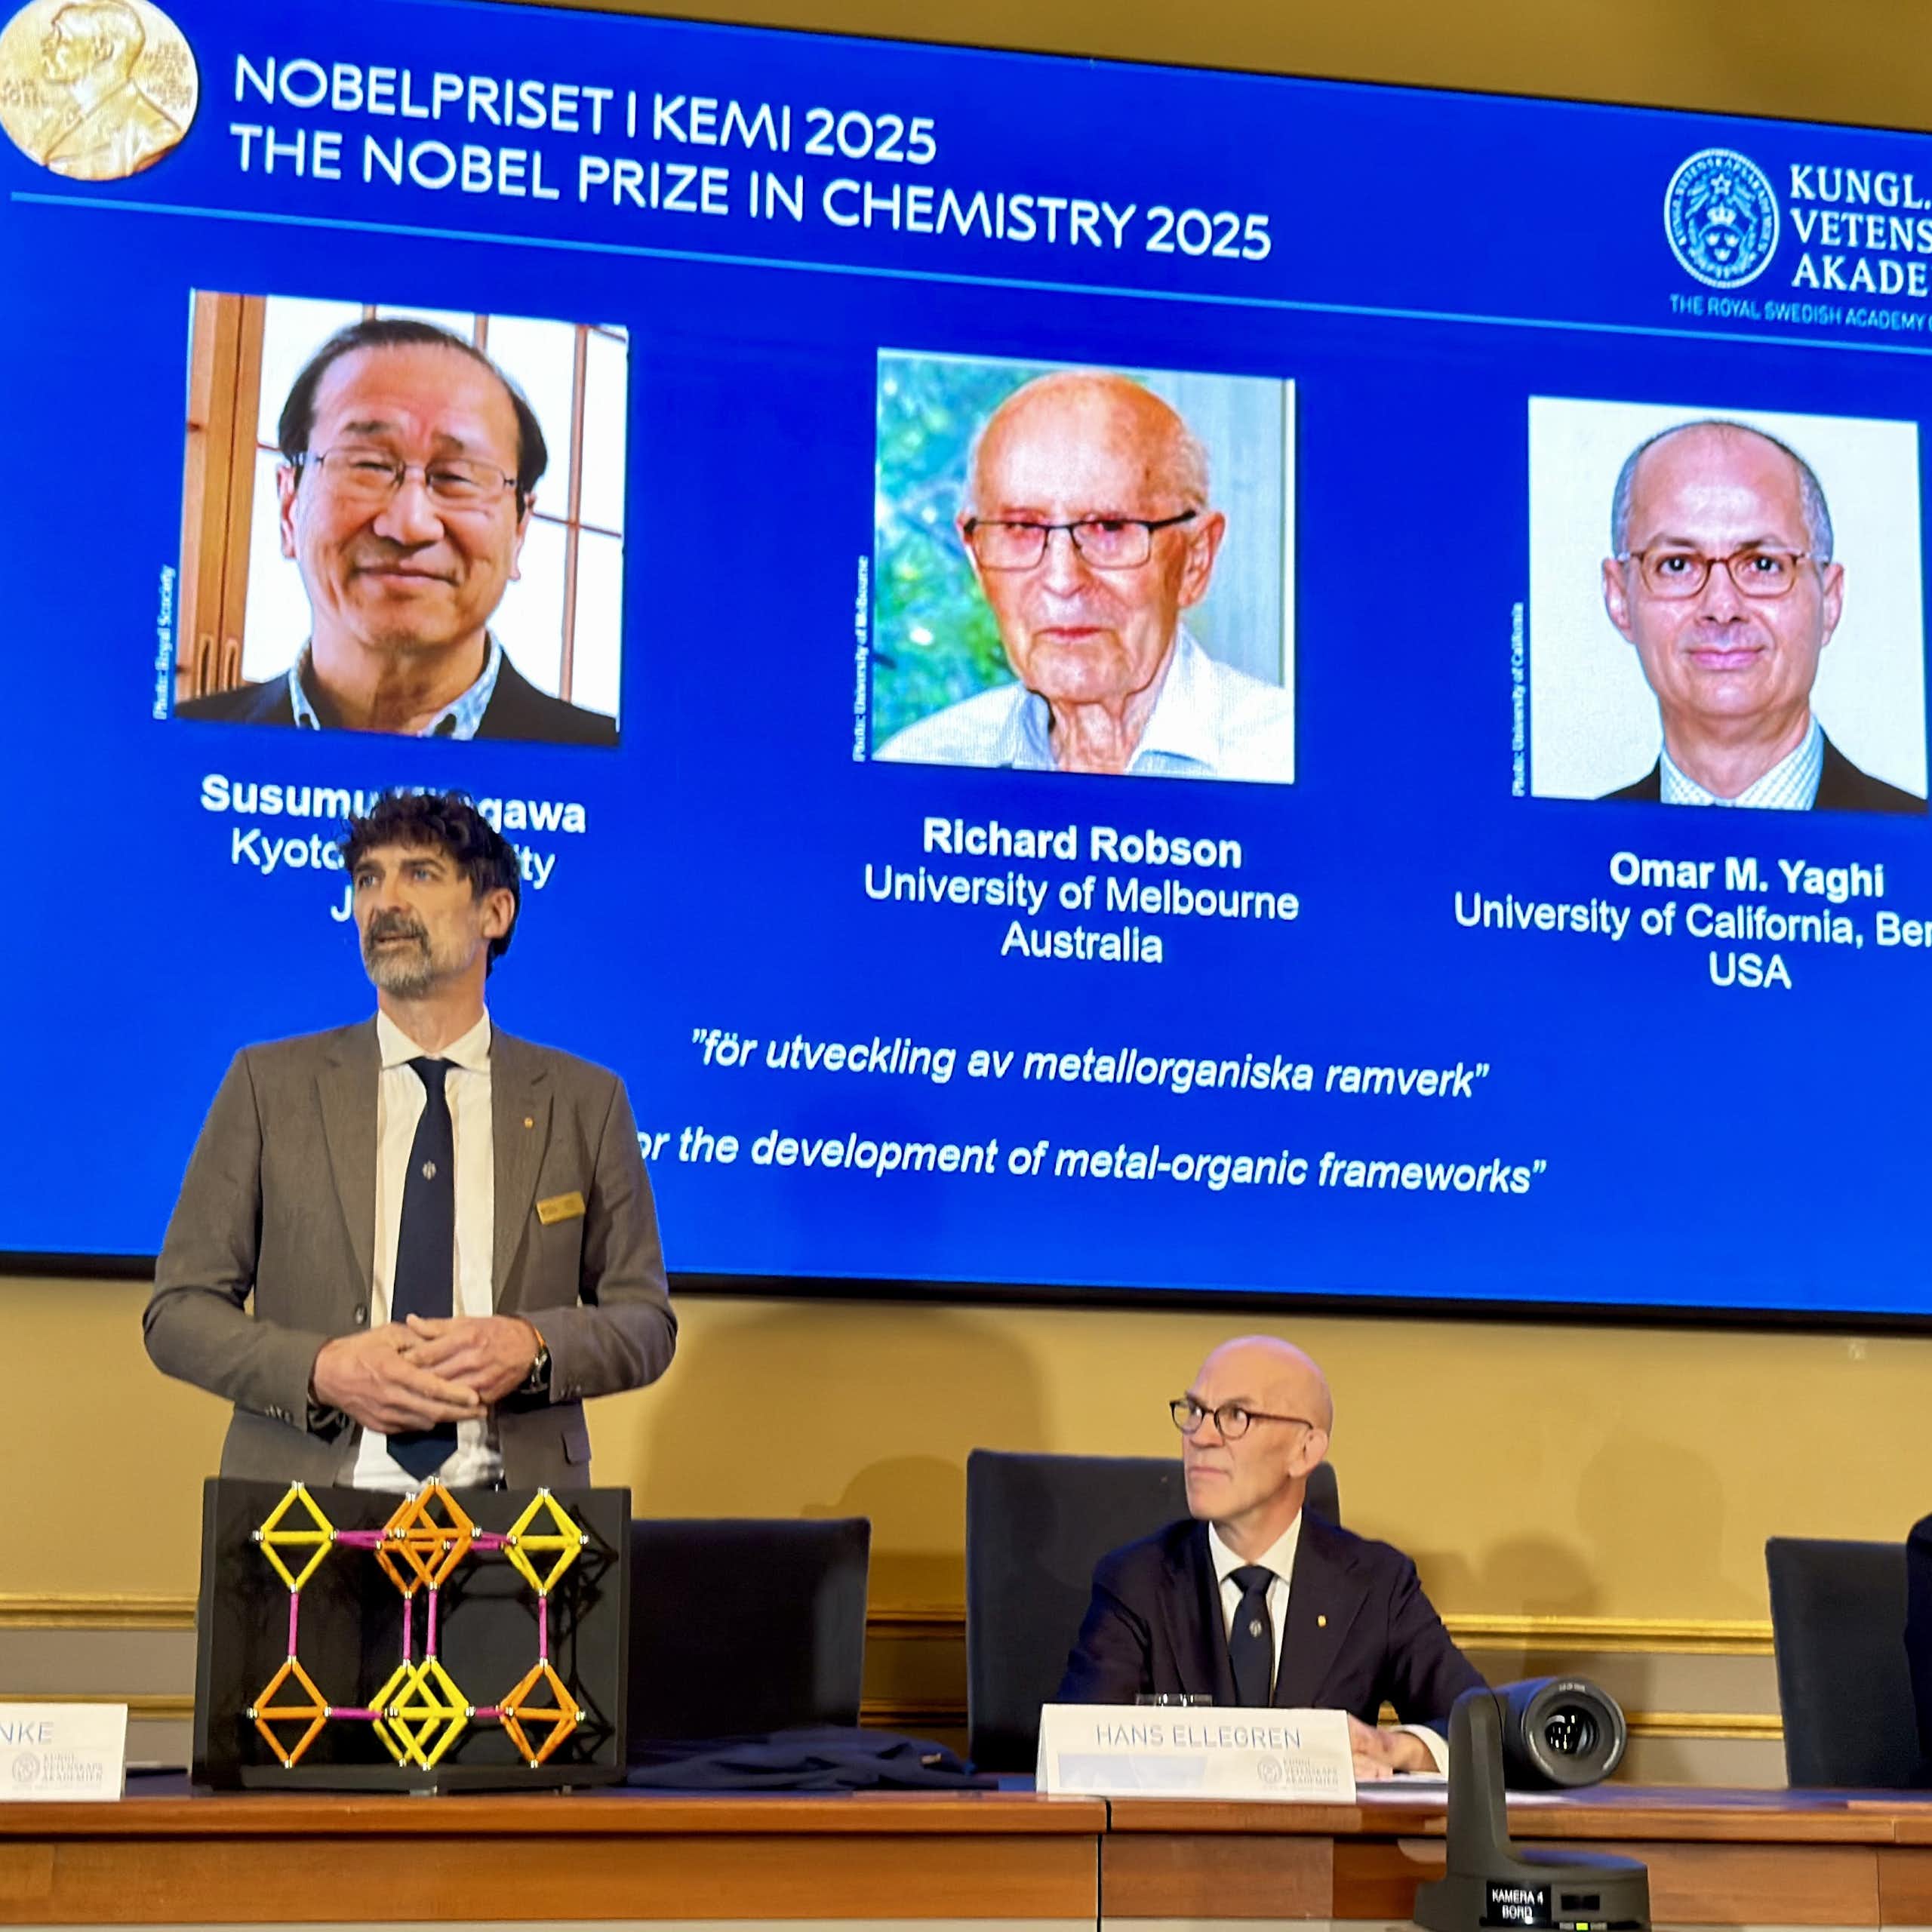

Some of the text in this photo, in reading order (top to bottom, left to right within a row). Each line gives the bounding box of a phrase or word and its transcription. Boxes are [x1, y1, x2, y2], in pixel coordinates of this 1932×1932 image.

[235, 54, 614, 135] NOBELPRISET
[626, 90, 636, 138] I
[653, 93, 791, 153] KEMI
[804, 107, 937, 165] 2025
[229, 122, 1272, 260] THE NOBEL PRIZE IN CHEMISTRY 2025
[1790, 164, 1931, 210] KUNGL.
[1789, 208, 1932, 254] VETENS
[1791, 253, 1928, 297] AKADE
[1669, 293, 1703, 316] THE
[1707, 296, 1761, 320] ROYAL
[1764, 300, 1842, 326] SWEDISH
[1844, 307, 1927, 331] ACADEMY
[200, 774, 379, 820] Susumu
[231, 827, 345, 875] Kyoto
[923, 817, 1242, 869] Richard Robson
[865, 863, 1300, 921] University of Melbourne
[1609, 851, 1884, 904] Omar M. Yaghi
[1001, 920, 1163, 964] Australia
[1454, 891, 1631, 942] University
[1641, 901, 1677, 937] of
[1685, 903, 1864, 949] California,
[1709, 951, 1792, 989] USA
[765, 1034, 957, 1084] utveckling
[967, 1049, 1014, 1078] av
[1023, 1047, 1314, 1094] metallorganiska
[1324, 1062, 1490, 1098] ramverk”
[637, 1125, 1547, 1194] or the development of metal-organic frameworks”
[1097, 1724, 1300, 1749] HANS ELLEGREN
